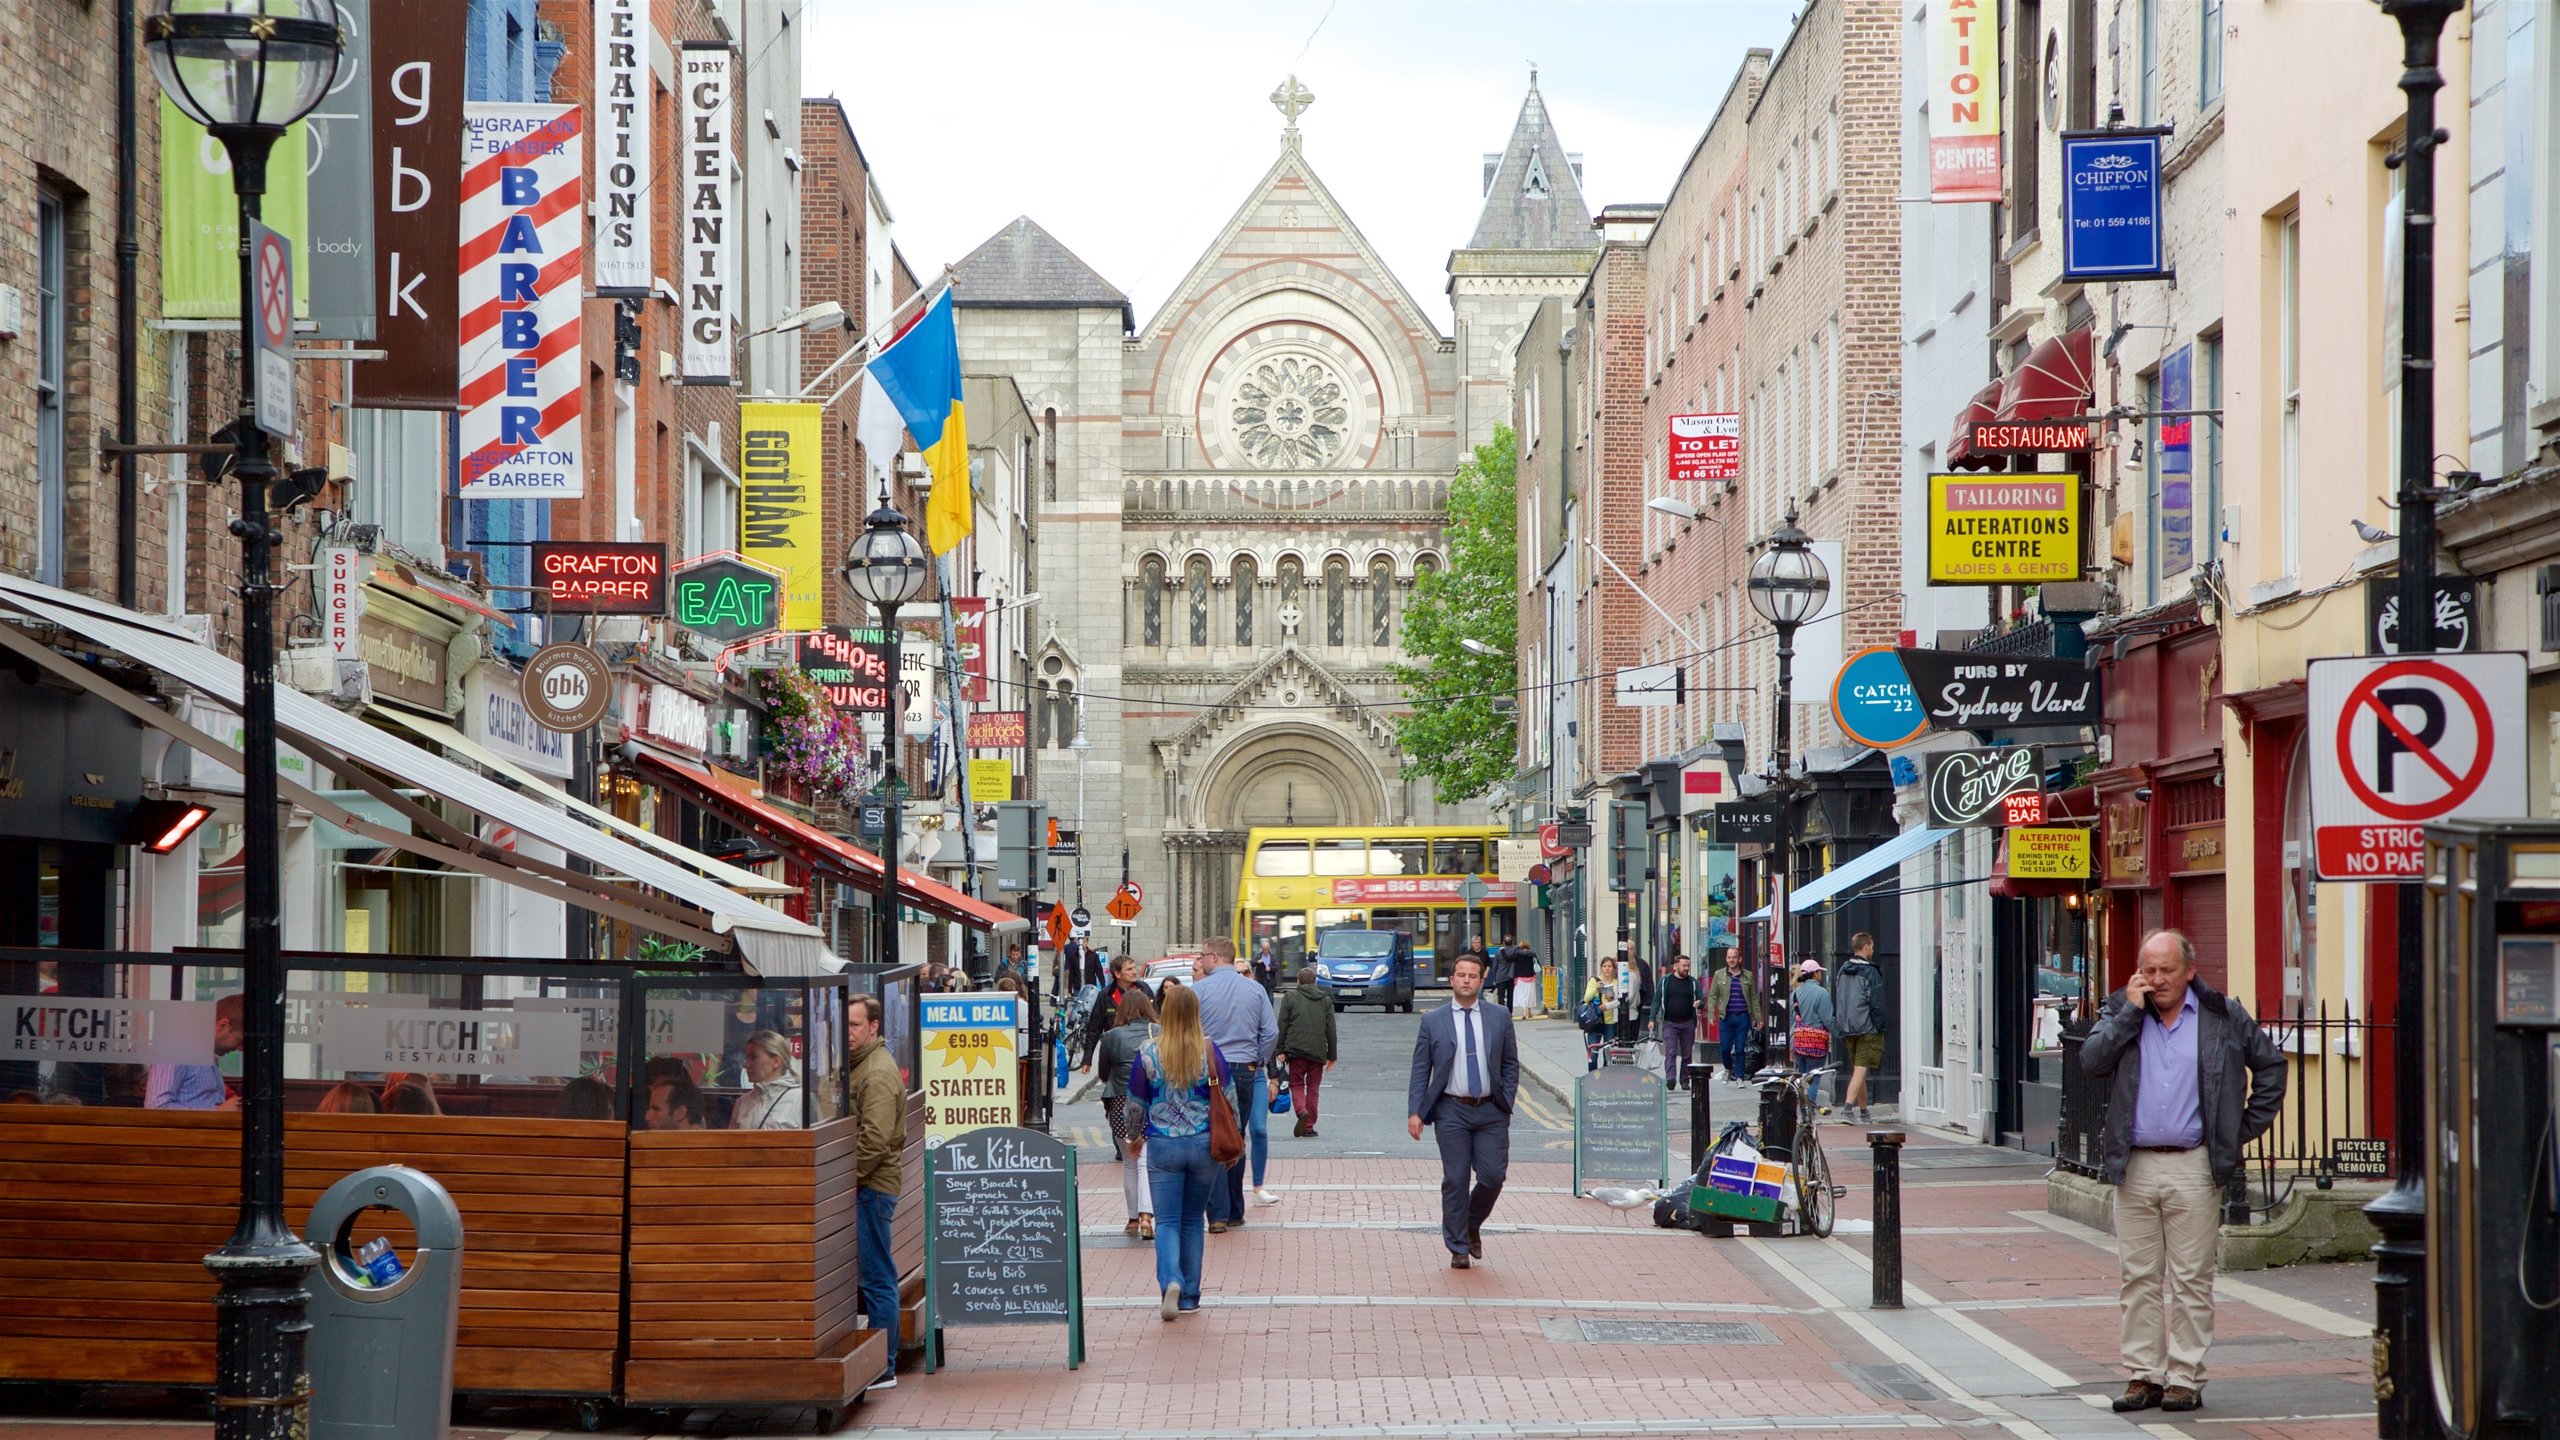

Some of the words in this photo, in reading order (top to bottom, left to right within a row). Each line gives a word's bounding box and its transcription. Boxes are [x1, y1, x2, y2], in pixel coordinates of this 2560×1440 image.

[688, 61, 724, 74] DRY
[486, 117, 574, 133] GRAFTON
[609, 0, 637, 247] ERATIONS
[470, 117, 484, 152] THE
[488, 139, 564, 155] BARBER
[1935, 147, 1996, 169] CENTRE
[2075, 170, 2148, 185] CHIFFON
[691, 82, 723, 345] CLEANING
[2074, 219, 2092, 228] Tel:
[2093, 218, 2105, 227] 01
[2108, 218, 2126, 227] 559
[2127, 217, 2151, 226] 4186
[317, 237, 362, 257] body
[600, 261, 646, 270] 016717813
[497, 167, 544, 444] BARBER
[1680, 417, 1713, 426] Mason
[1679, 441, 1703, 451] TO
[1709, 440, 1738, 450] LET
[486, 451, 573, 466] GRAFTON
[470, 451, 485, 486] THE
[489, 473, 565, 487] BARBER
[745, 430, 813, 549] GOTHAM
[1955, 488, 2057, 505] TAILORING
[1945, 517, 2070, 536] ALTERATIONS
[1971, 540, 2042, 558] CENTRE
[544, 554, 657, 574] GRAFTON
[1945, 563, 1999, 575] LADIES
[2002, 563, 2012, 574] &
[2018, 562, 2069, 574] GENTS
[552, 580, 648, 600] BARBER
[333, 554, 347, 652] SURGERY
[681, 577, 772, 627] EAT
[535, 651, 571, 674] gourmet
[573, 652, 599, 677] burger
[1954, 665, 1998, 679] FURS
[2005, 664, 2028, 678] BY
[809, 669, 854, 683] SPIRITS
[546, 673, 586, 699] gbk
[1853, 684, 1911, 698] CATCH
[1893, 700, 1913, 712] 22
[1932, 682, 2023, 724] Sydney
[2029, 679, 2089, 712] Vard
[488, 693, 526, 747] GALLERY
[547, 711, 583, 723] kitchen
[994, 714, 1020, 722] O'NEILL
[1981, 752, 1999, 765] LA
[1931, 749, 2038, 824] Cave
[2006, 796, 2039, 807] WINE
[1721, 814, 1772, 822] LINKS
[2009, 809, 2040, 822] BAR
[2019, 834, 2080, 842] ALTERATION
[2360, 828, 2424, 848] STRIC
[2031, 843, 2070, 851] CENTRE
[2347, 852, 2378, 872] NO
[2385, 852, 2424, 872] PAR
[1388, 880, 1416, 892] BIG
[927, 1006, 967, 1022] MEAL
[973, 1006, 1010, 1021] DEAL
[385, 1019, 521, 1050] KITCHEN
[948, 1033, 989, 1048] €9.99
[384, 1051, 520, 1065] RESTAURANT
[930, 1078, 1006, 1096] STARTER
[925, 1106, 937, 1125] &
[945, 1107, 1011, 1125] BURGER
[946, 1143, 979, 1170] The
[987, 1137, 1053, 1169] Kitchen
[2337, 1141, 2386, 1152] BICYCLES
[2337, 1163, 2386, 1174] REMOVED
[946, 1178, 976, 1191] Soup:
[1021, 1190, 1049, 1201] €4.95
[940, 1205, 979, 1220] Special:
[982, 1204, 1009, 1215] Grilled
[940, 1218, 967, 1227] steak
[968, 1266, 996, 1280] Early
[1003, 1265, 1026, 1278] Bird
[952, 1282, 960, 1295] 2
[965, 1286, 1004, 1295] courses
[1012, 1284, 1047, 1295] €19.95
[966, 1297, 1000, 1311] served
[1004, 1302, 1021, 1312] ALL
[1023, 1299, 1065, 1312] EVENING
